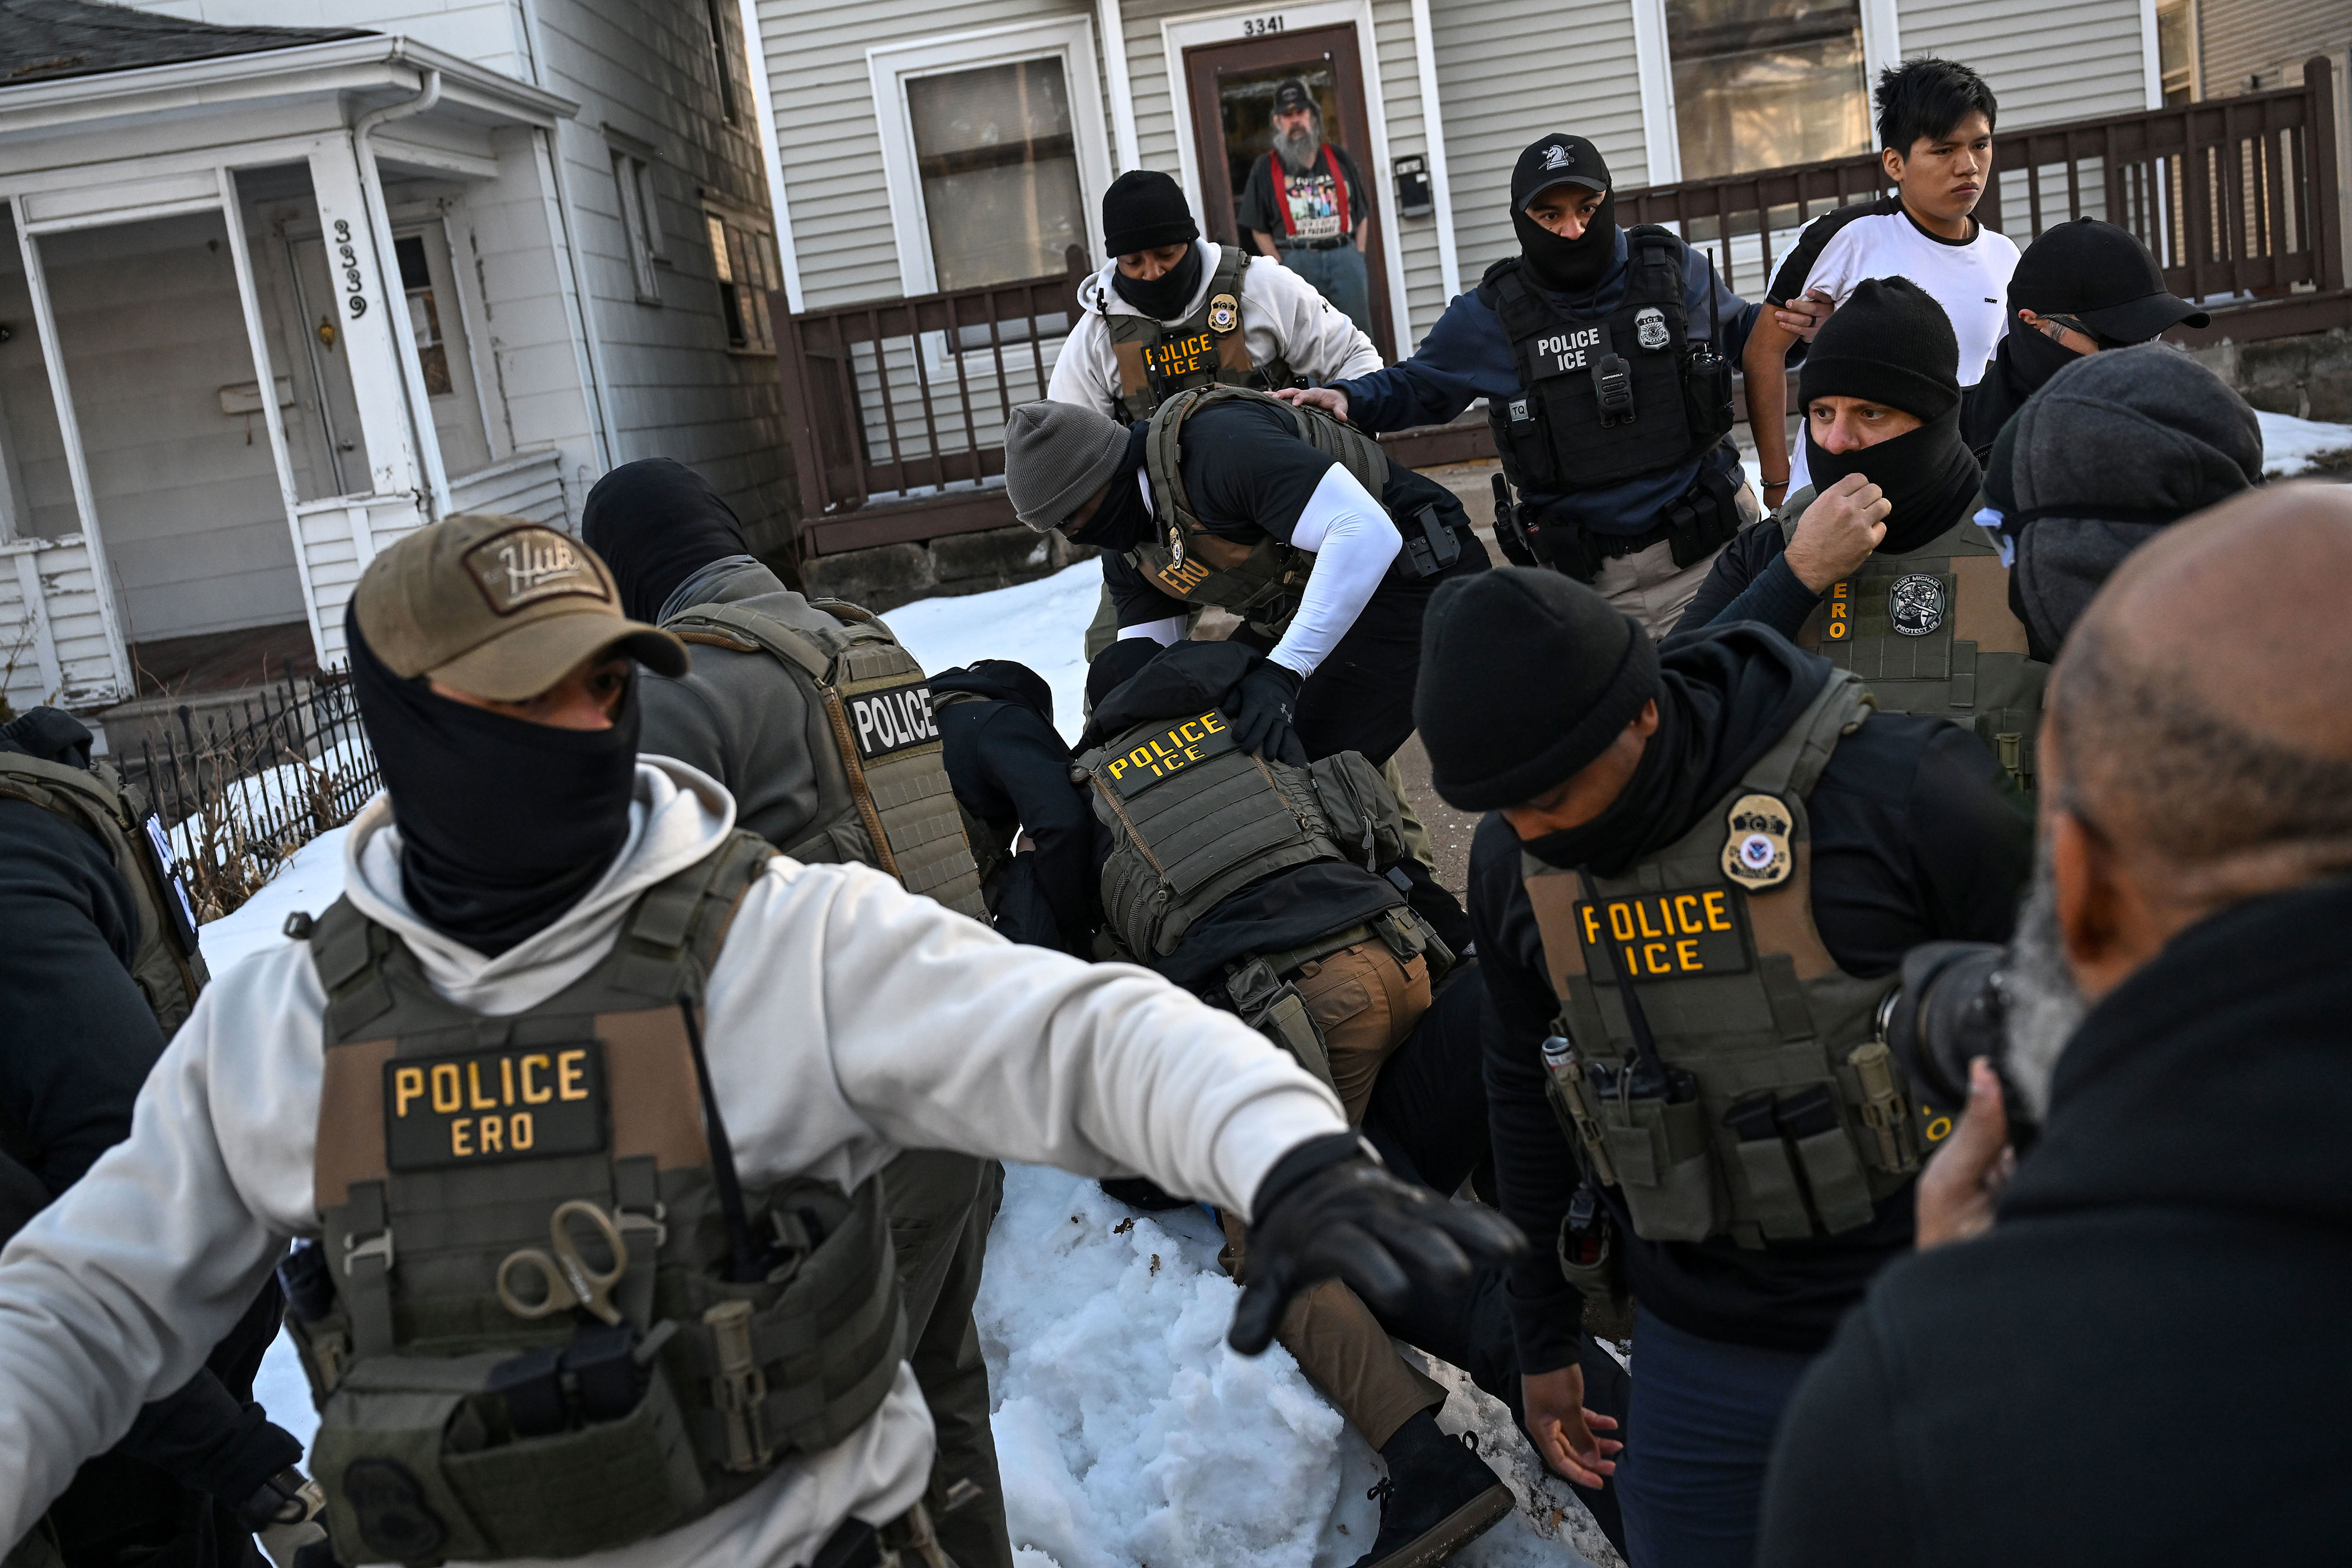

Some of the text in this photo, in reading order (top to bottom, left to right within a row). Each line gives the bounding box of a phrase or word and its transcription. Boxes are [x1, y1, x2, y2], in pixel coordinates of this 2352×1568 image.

[1244, 15, 1283, 35] 3341
[334, 219, 367, 319] 3339
[1145, 333, 1212, 365] POLICE
[1537, 328, 1599, 356] POLICE
[1165, 356, 1201, 376] ICE
[1557, 350, 1588, 371] ICE
[1512, 405, 1526, 415] TQ
[1893, 576, 1939, 591] SAINT MICHAEL
[1829, 583, 1848, 638] ERO
[1896, 624, 1927, 634] PROTECT
[853, 688, 939, 753] POLICE
[1108, 712, 1226, 780] POLICE
[1151, 744, 1206, 777] ICE
[1582, 891, 1732, 944] POLICE
[1625, 939, 1704, 975] ICE
[395, 1049, 589, 1118] POLICE
[451, 1112, 534, 1156] ERO
